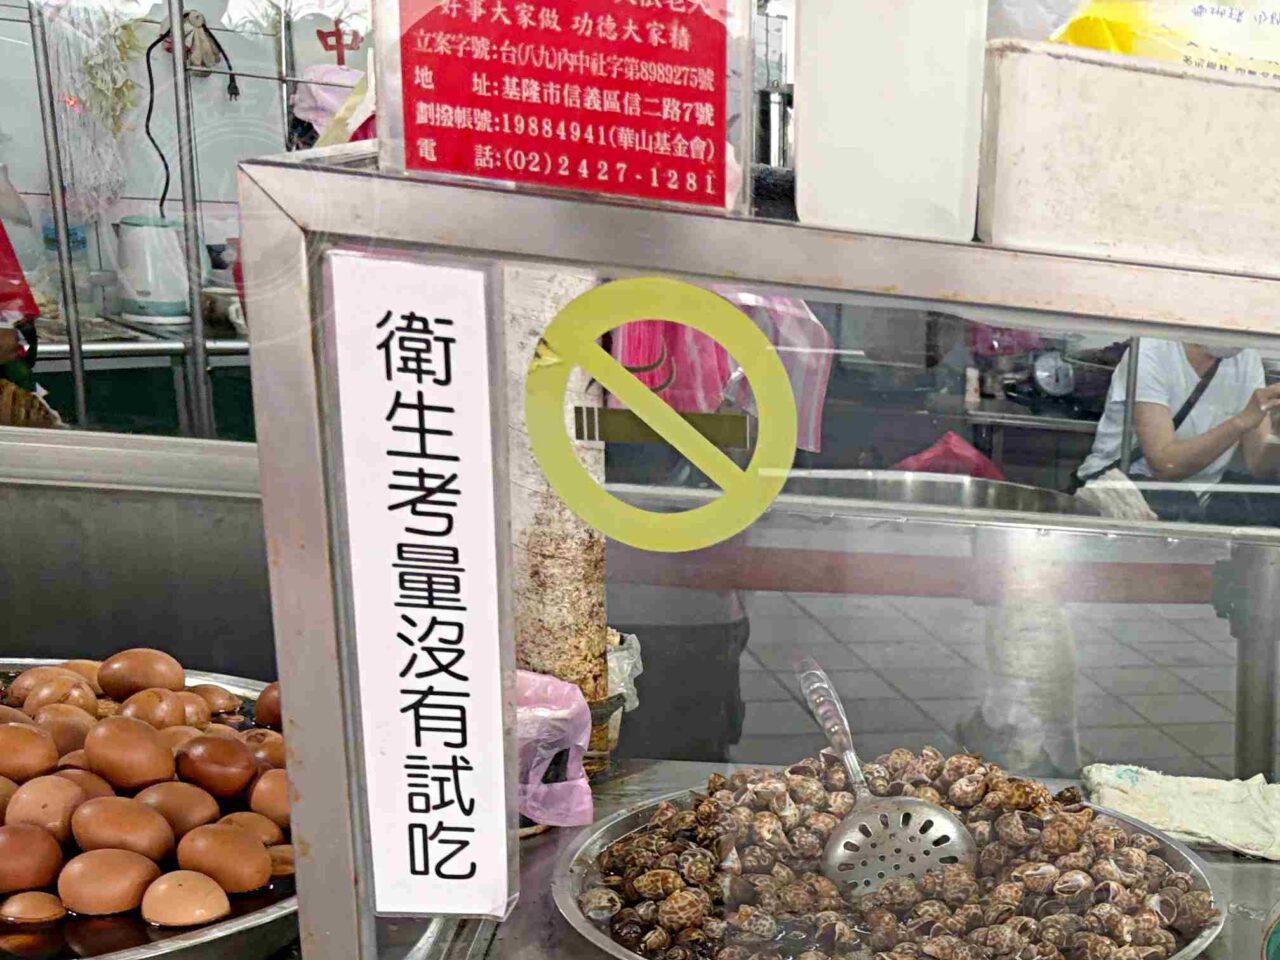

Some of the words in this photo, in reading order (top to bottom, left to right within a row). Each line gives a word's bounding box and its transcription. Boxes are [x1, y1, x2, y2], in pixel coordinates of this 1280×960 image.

[376, 309, 477, 880] 衛生考量沒有試吃
